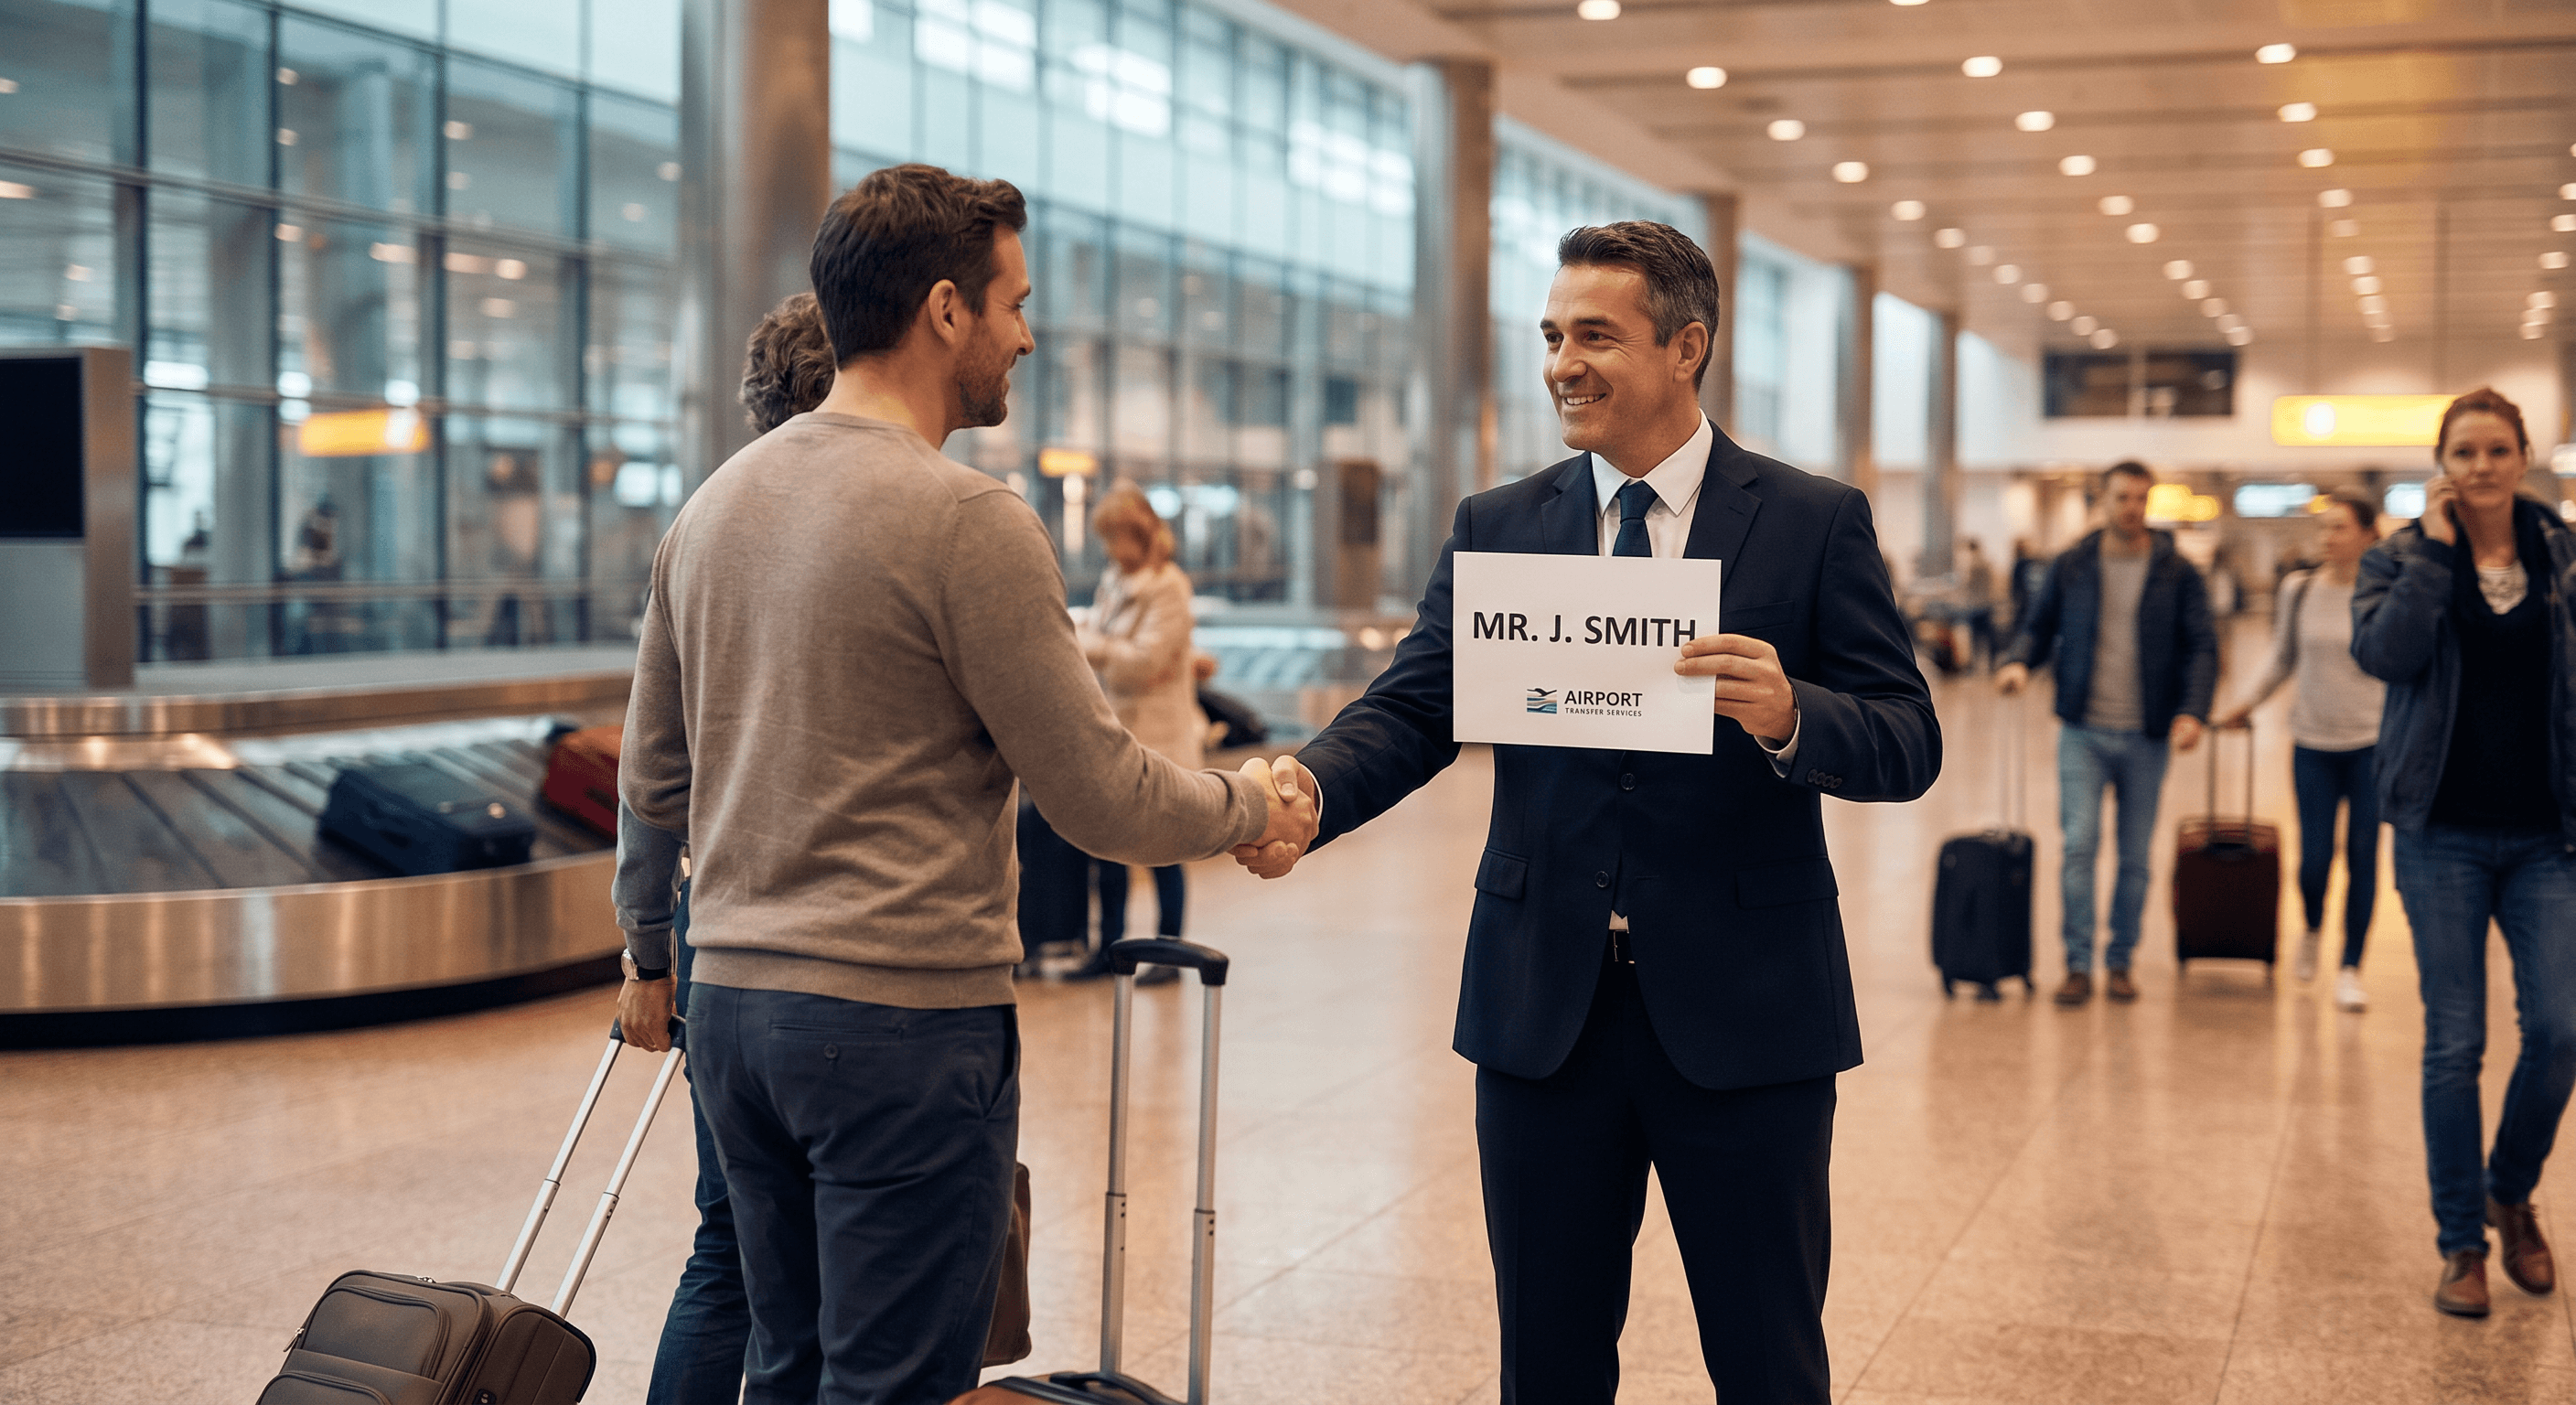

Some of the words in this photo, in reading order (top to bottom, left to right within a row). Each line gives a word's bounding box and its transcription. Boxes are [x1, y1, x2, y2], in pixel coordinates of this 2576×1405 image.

[1473, 611, 1539, 642] MR.
[1549, 614, 1572, 644] J.
[1583, 615, 1696, 648] SMITH
[1563, 690, 1643, 707] AIRPORT
[1565, 707, 1604, 715] TRANSFER
[1606, 709, 1642, 717] SERVICES
